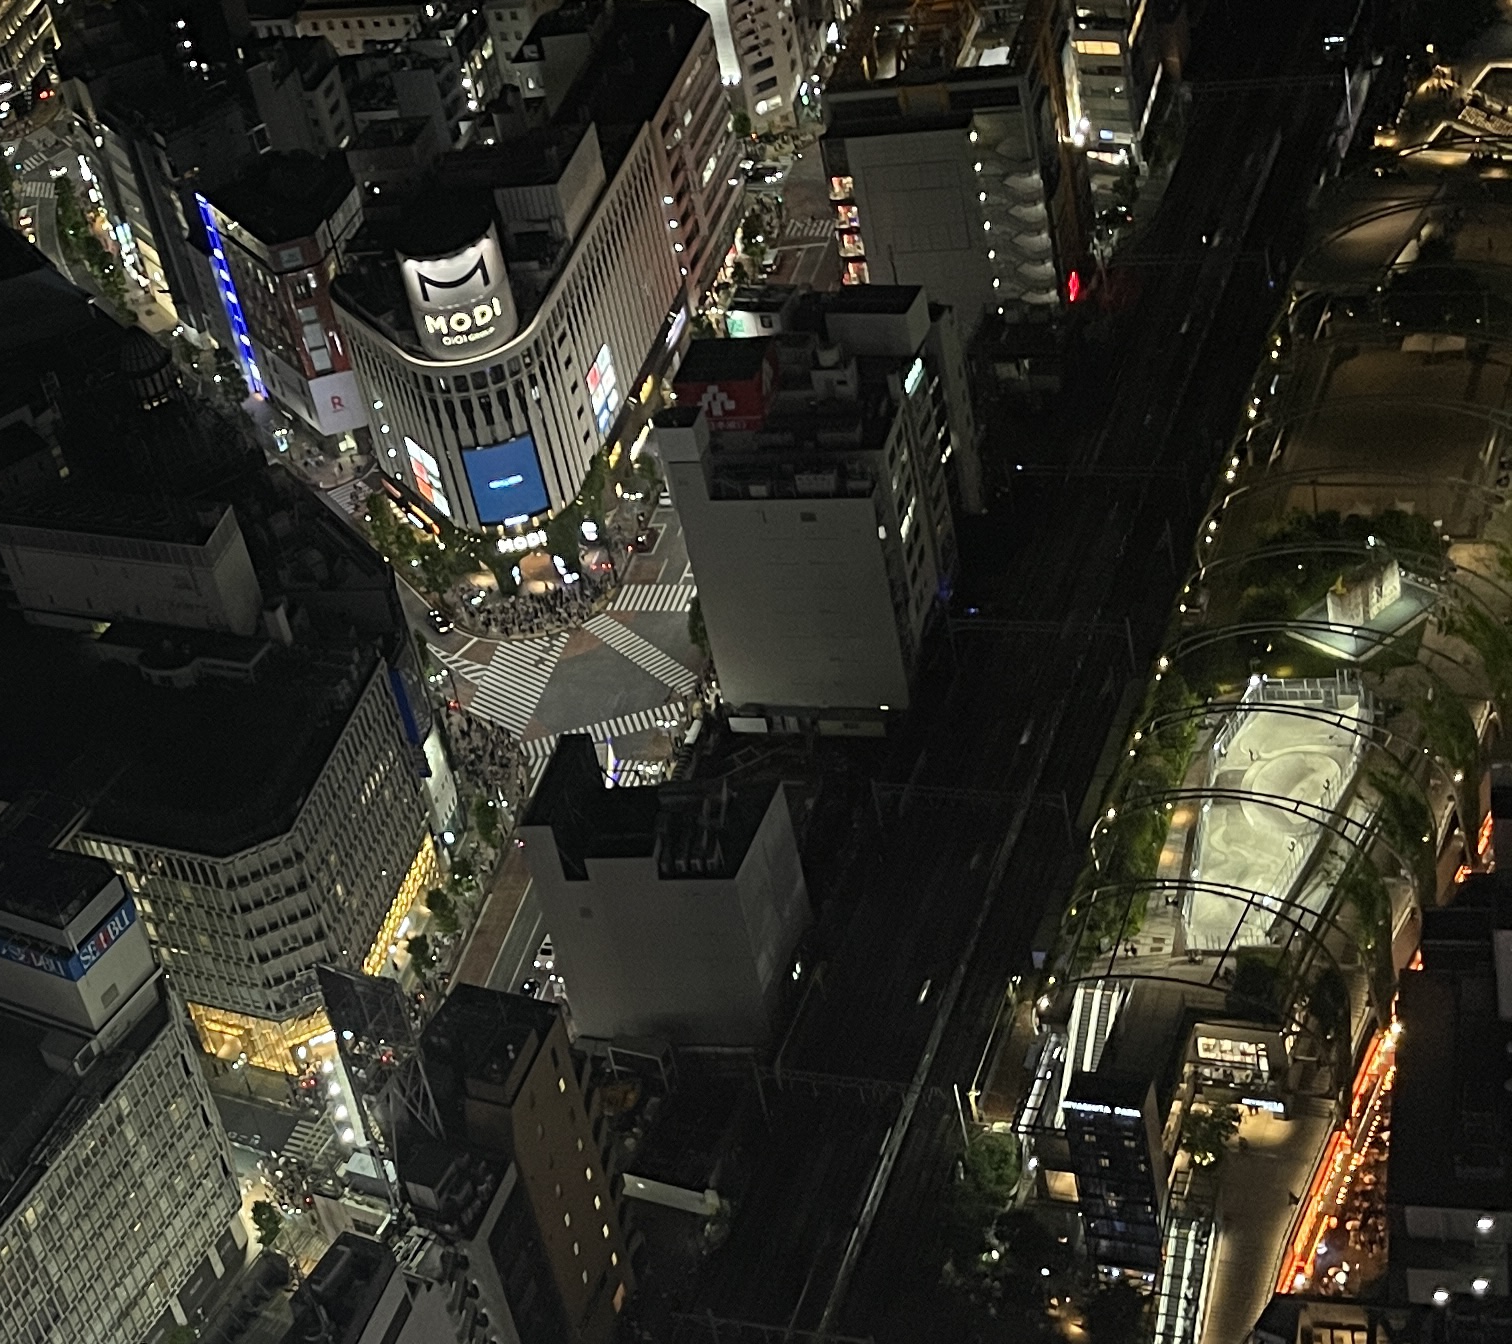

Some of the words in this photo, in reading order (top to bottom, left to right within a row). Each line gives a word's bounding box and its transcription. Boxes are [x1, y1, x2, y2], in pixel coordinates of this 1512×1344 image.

[424, 297, 502, 335] MODI
[497, 529, 547, 554] MODI
[76, 909, 131, 970] SEIBU
